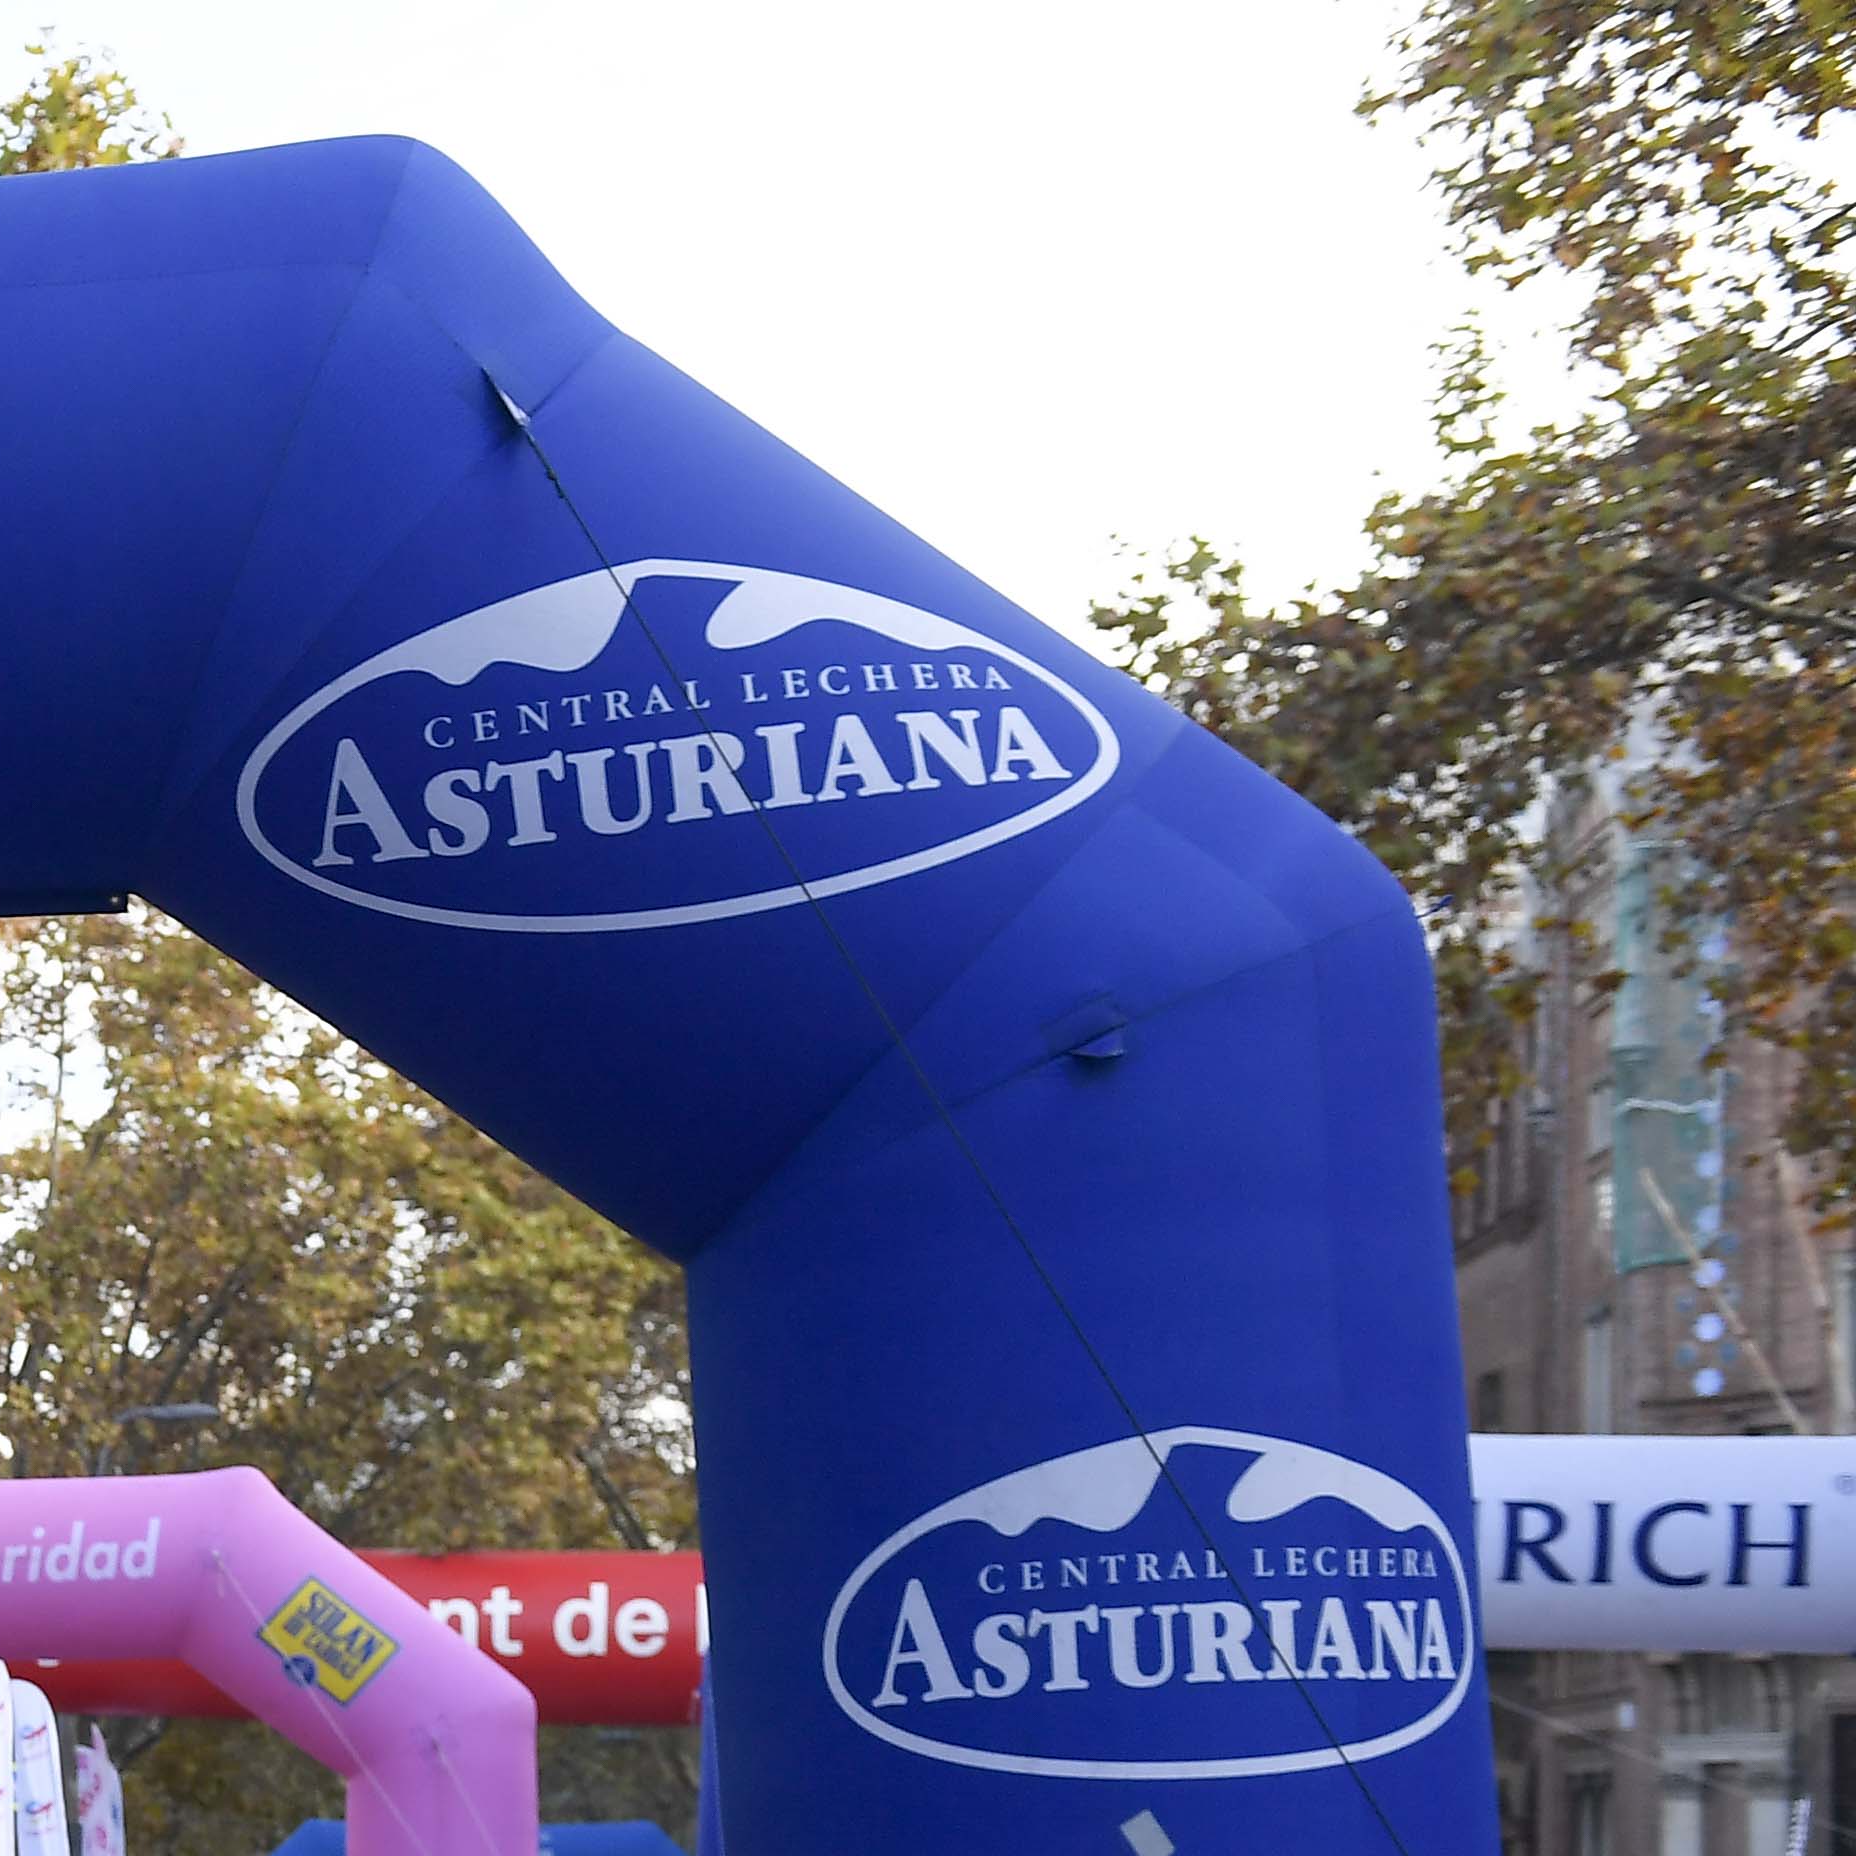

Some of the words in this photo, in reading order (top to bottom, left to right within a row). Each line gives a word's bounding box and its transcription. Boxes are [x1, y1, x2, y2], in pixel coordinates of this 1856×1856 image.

[424, 680, 711, 750] CENTRAL
[743, 663, 1013, 705] LECHERA
[311, 706, 1072, 869] ASTURIANA
[978, 1550, 1228, 1594] CENTRAL
[1253, 1545, 1438, 1579] LECHERA
[1474, 1500, 1813, 1588] RICH
[552, 1581, 670, 1658] de
[872, 1578, 1457, 1708] ASTURIANA
